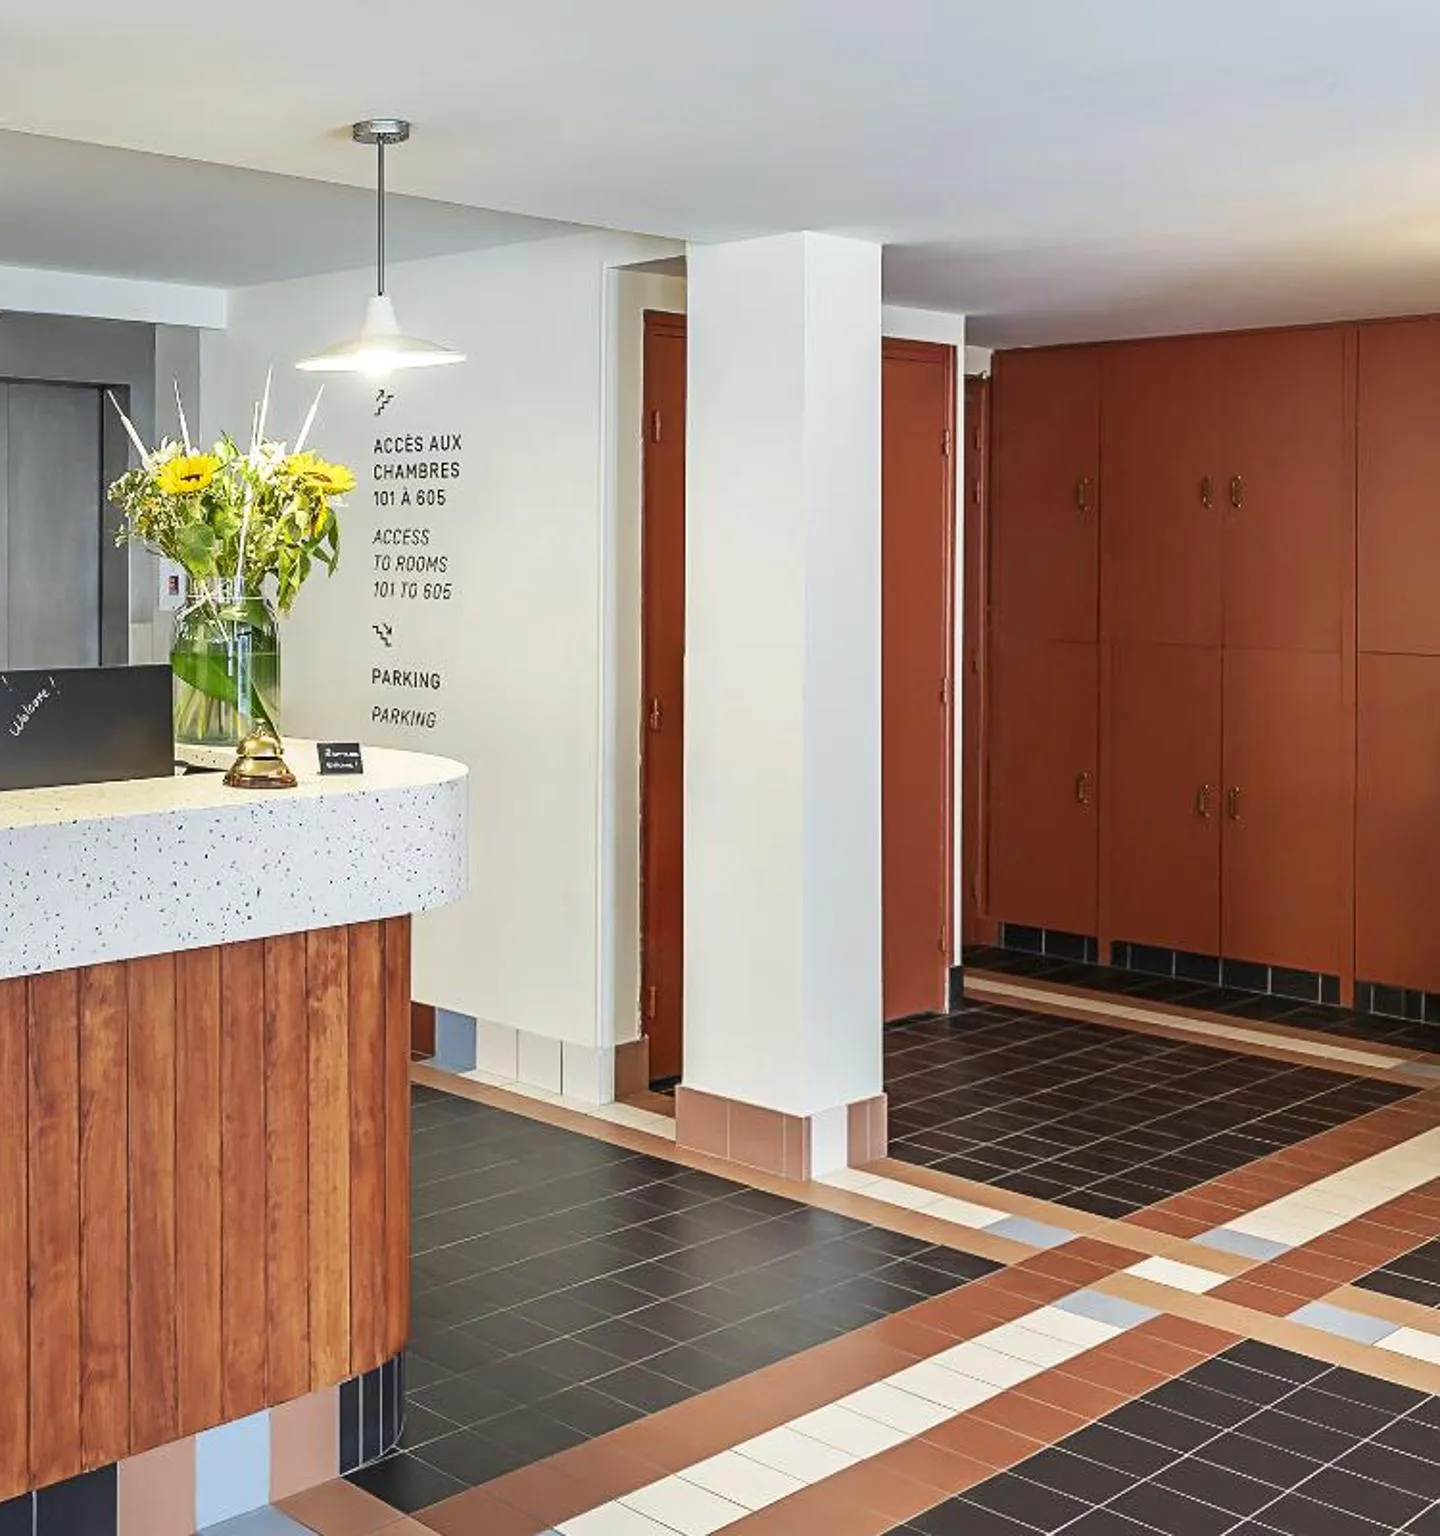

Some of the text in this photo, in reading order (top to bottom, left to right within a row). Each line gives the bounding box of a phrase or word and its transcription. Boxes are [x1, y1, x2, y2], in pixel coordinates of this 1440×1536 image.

[373, 433, 462, 454] ACCÈS AUX
[373, 462, 460, 481] CHAMBRES
[373, 486, 446, 507] 101 À 605
[372, 527, 430, 546] ACCESS
[374, 554, 448, 574] TO ROOMS
[374, 581, 452, 601] 101 TO 605
[371, 667, 441, 690] PARKING
[371, 705, 437, 729] PARKING
